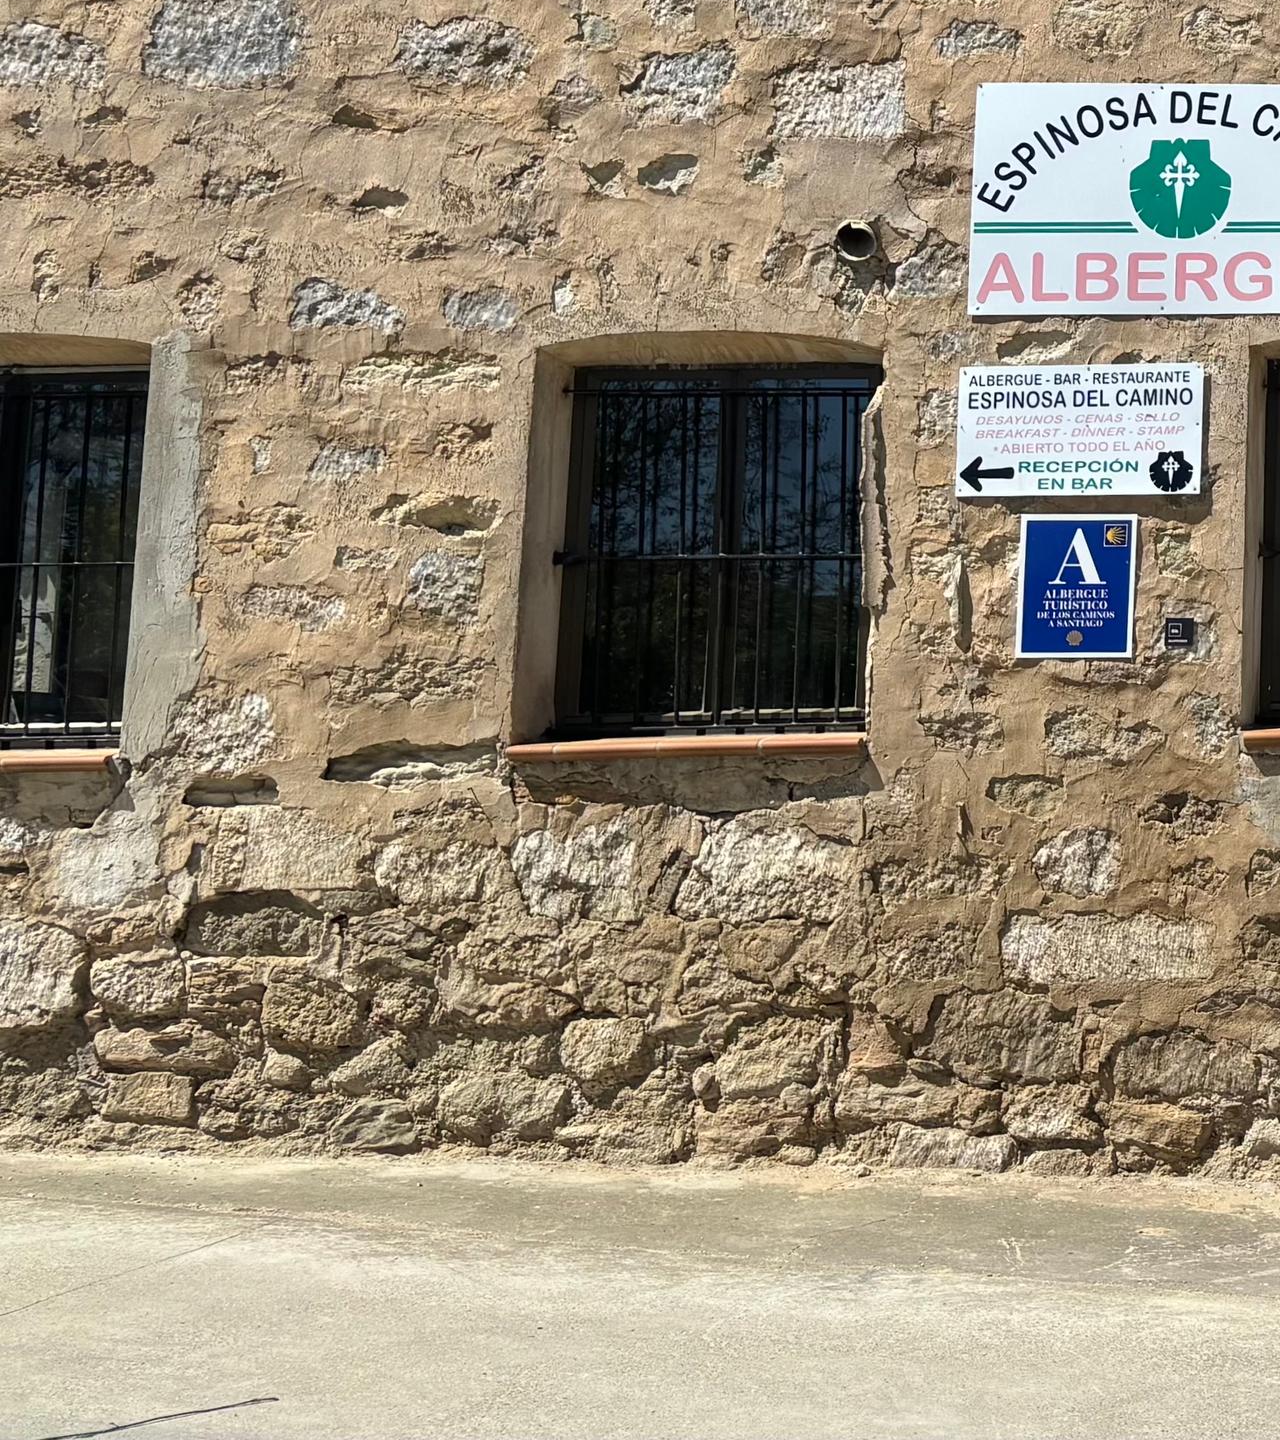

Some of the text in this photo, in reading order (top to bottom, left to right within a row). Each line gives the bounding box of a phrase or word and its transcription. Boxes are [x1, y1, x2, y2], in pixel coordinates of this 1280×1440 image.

[977, 92, 1157, 212] ESPINOSA
[1169, 91, 1239, 128] DEL
[969, 373, 1043, 387] ALBERGUE
[1054, 373, 1081, 385] BAR
[1092, 371, 1190, 385] RESTAURANTE
[968, 387, 1193, 409] ESPINOSA DEL CAMINO
[976, 414, 1063, 426] DESAYUNOS
[1074, 413, 1123, 424] CENAS
[1135, 412, 1180, 423] SELLO
[975, 428, 1060, 439] BREAKFAST
[1071, 427, 1126, 437] DINNER
[1137, 425, 1185, 436] STAMP
[1000, 438, 1166, 454] ABIERTO TODO EL AÑO
[1018, 458, 1139, 473] RECEPCIÓN
[1038, 478, 1113, 490] EN BAR
[1048, 528, 1106, 585] A
[1044, 589, 1108, 599] ALBERGUE
[1043, 598, 1108, 610] TURÍSTICO
[1037, 611, 1115, 619] DE LOS CAMINOS
